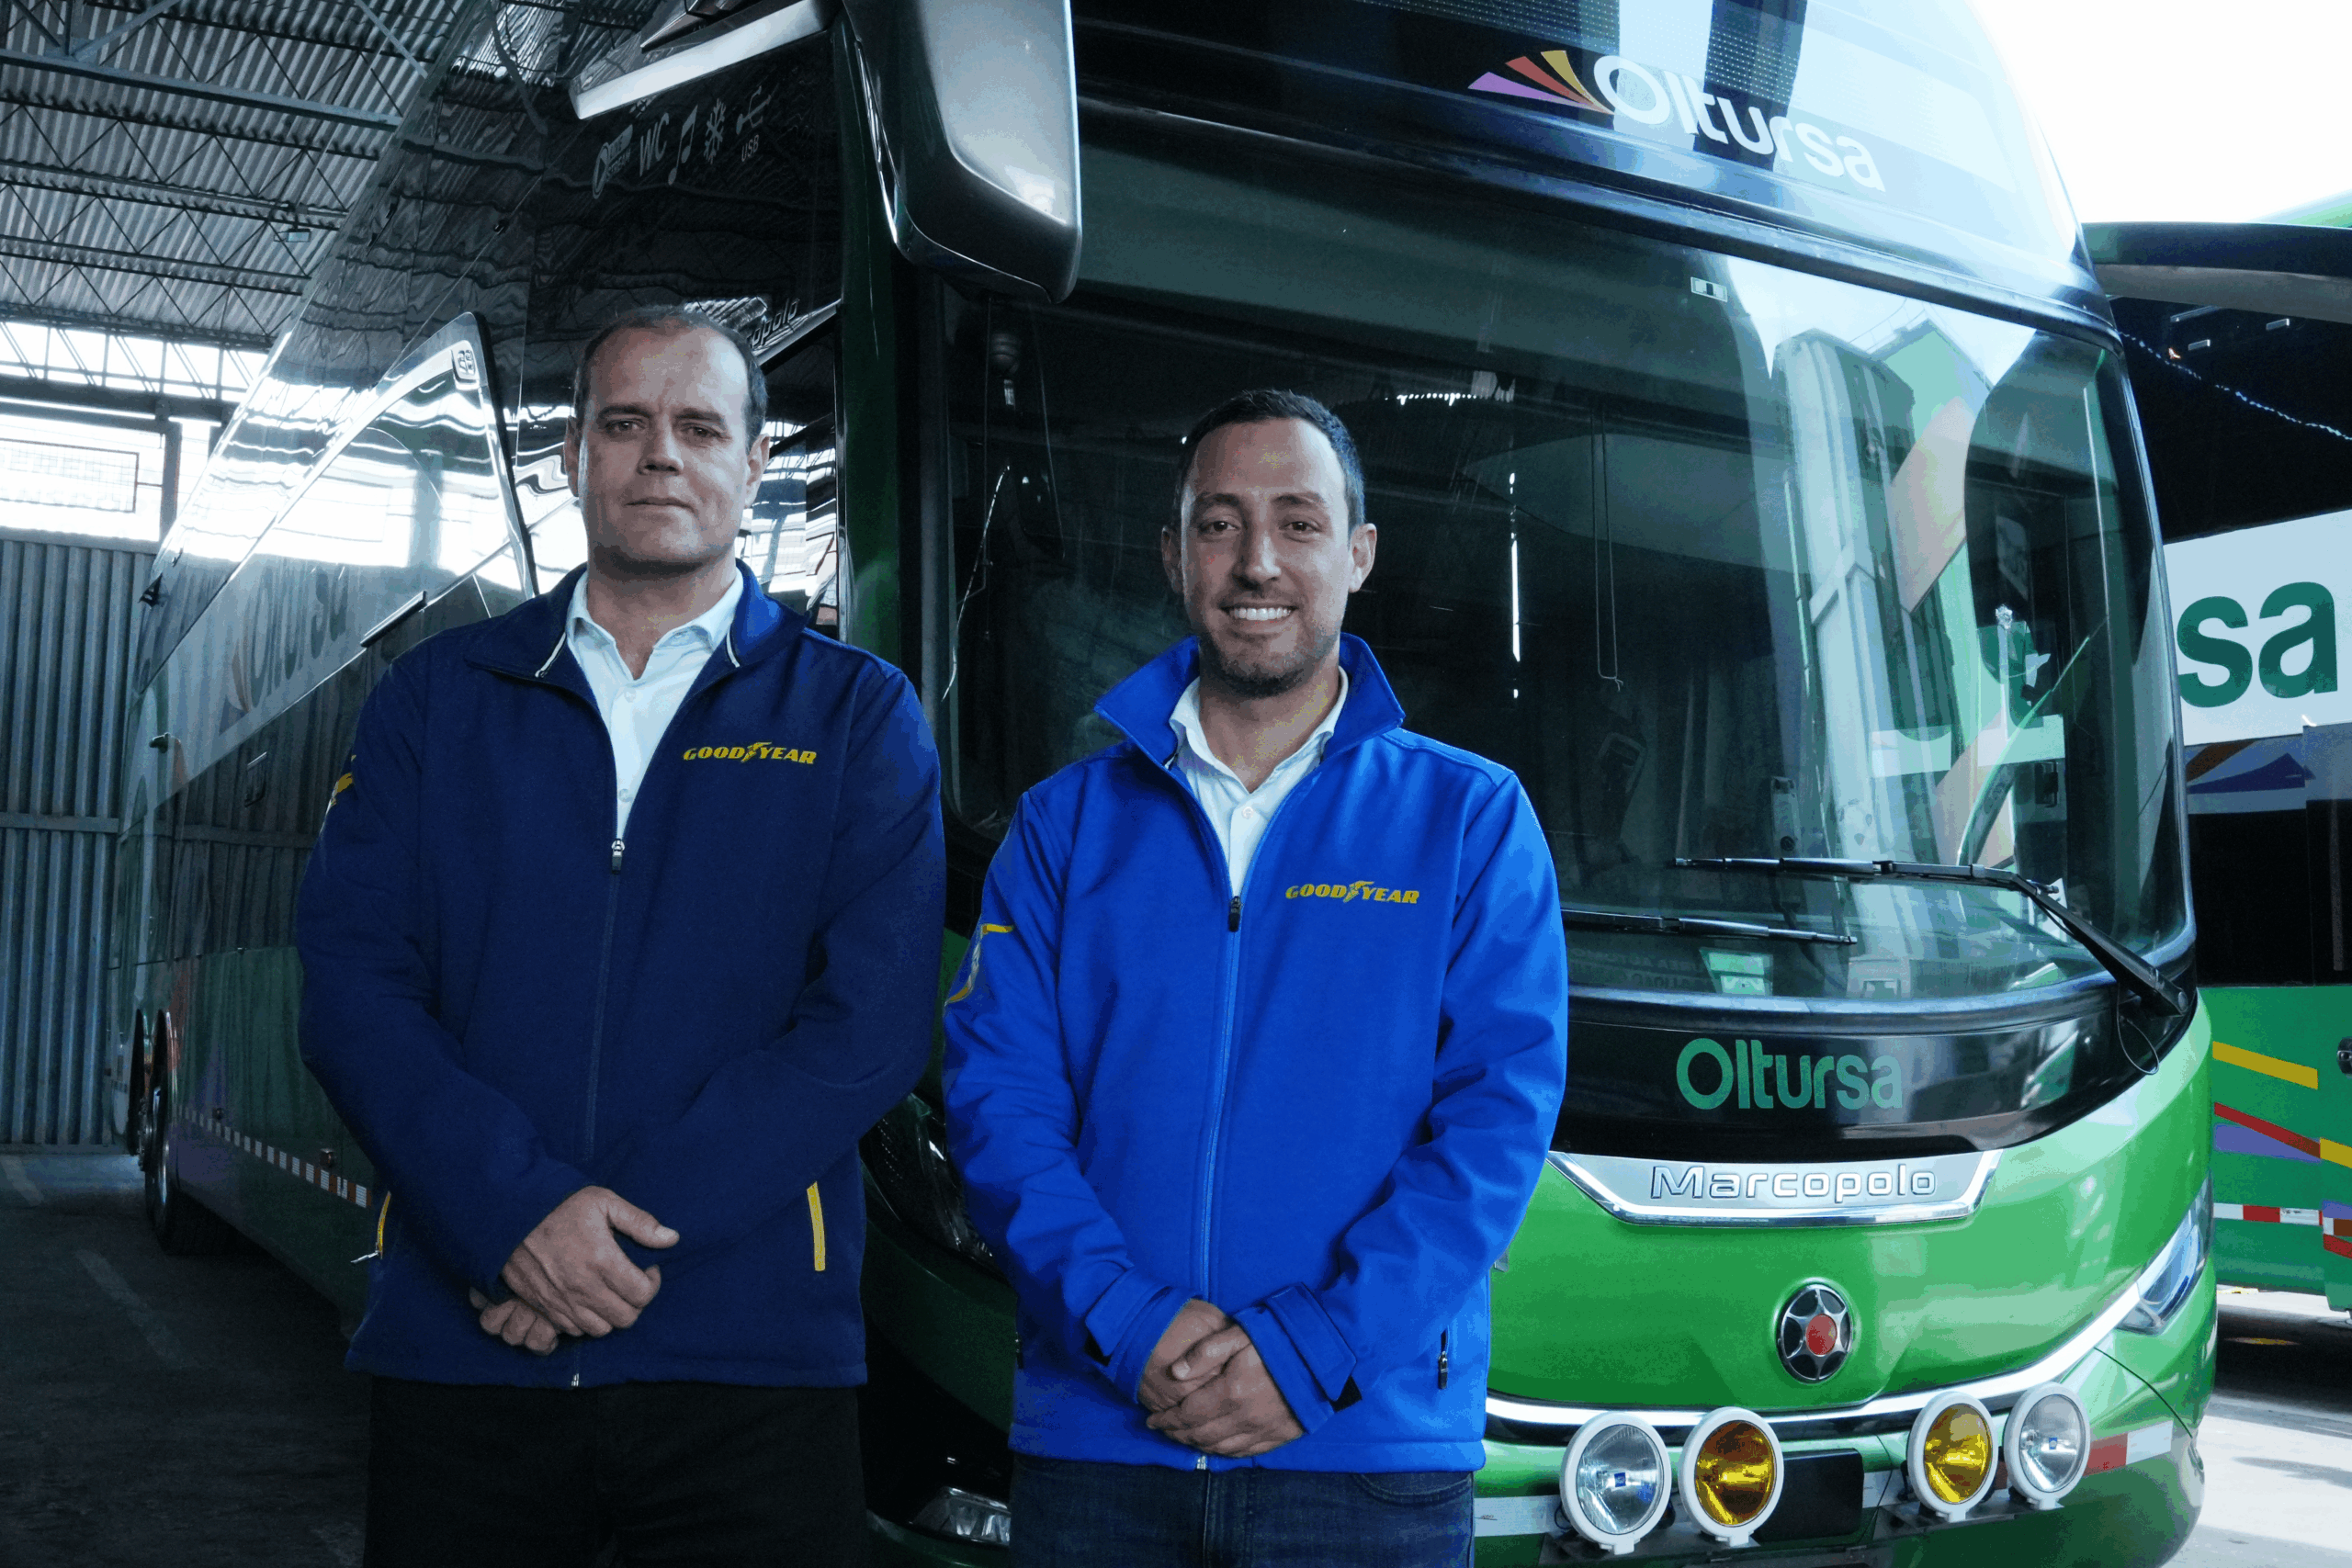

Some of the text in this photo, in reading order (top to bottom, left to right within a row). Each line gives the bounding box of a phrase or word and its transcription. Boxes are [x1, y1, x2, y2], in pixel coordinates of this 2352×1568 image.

[1594, 55, 1886, 192] Oltursa
[639, 111, 670, 177] WC
[741, 134, 760, 163] USB
[683, 741, 818, 764] GOODYEAR
[1284, 880, 1420, 904] GOODYEAR
[1676, 1037, 1903, 1110] Oltursa
[1650, 1164, 1936, 1204] Marcopolo
